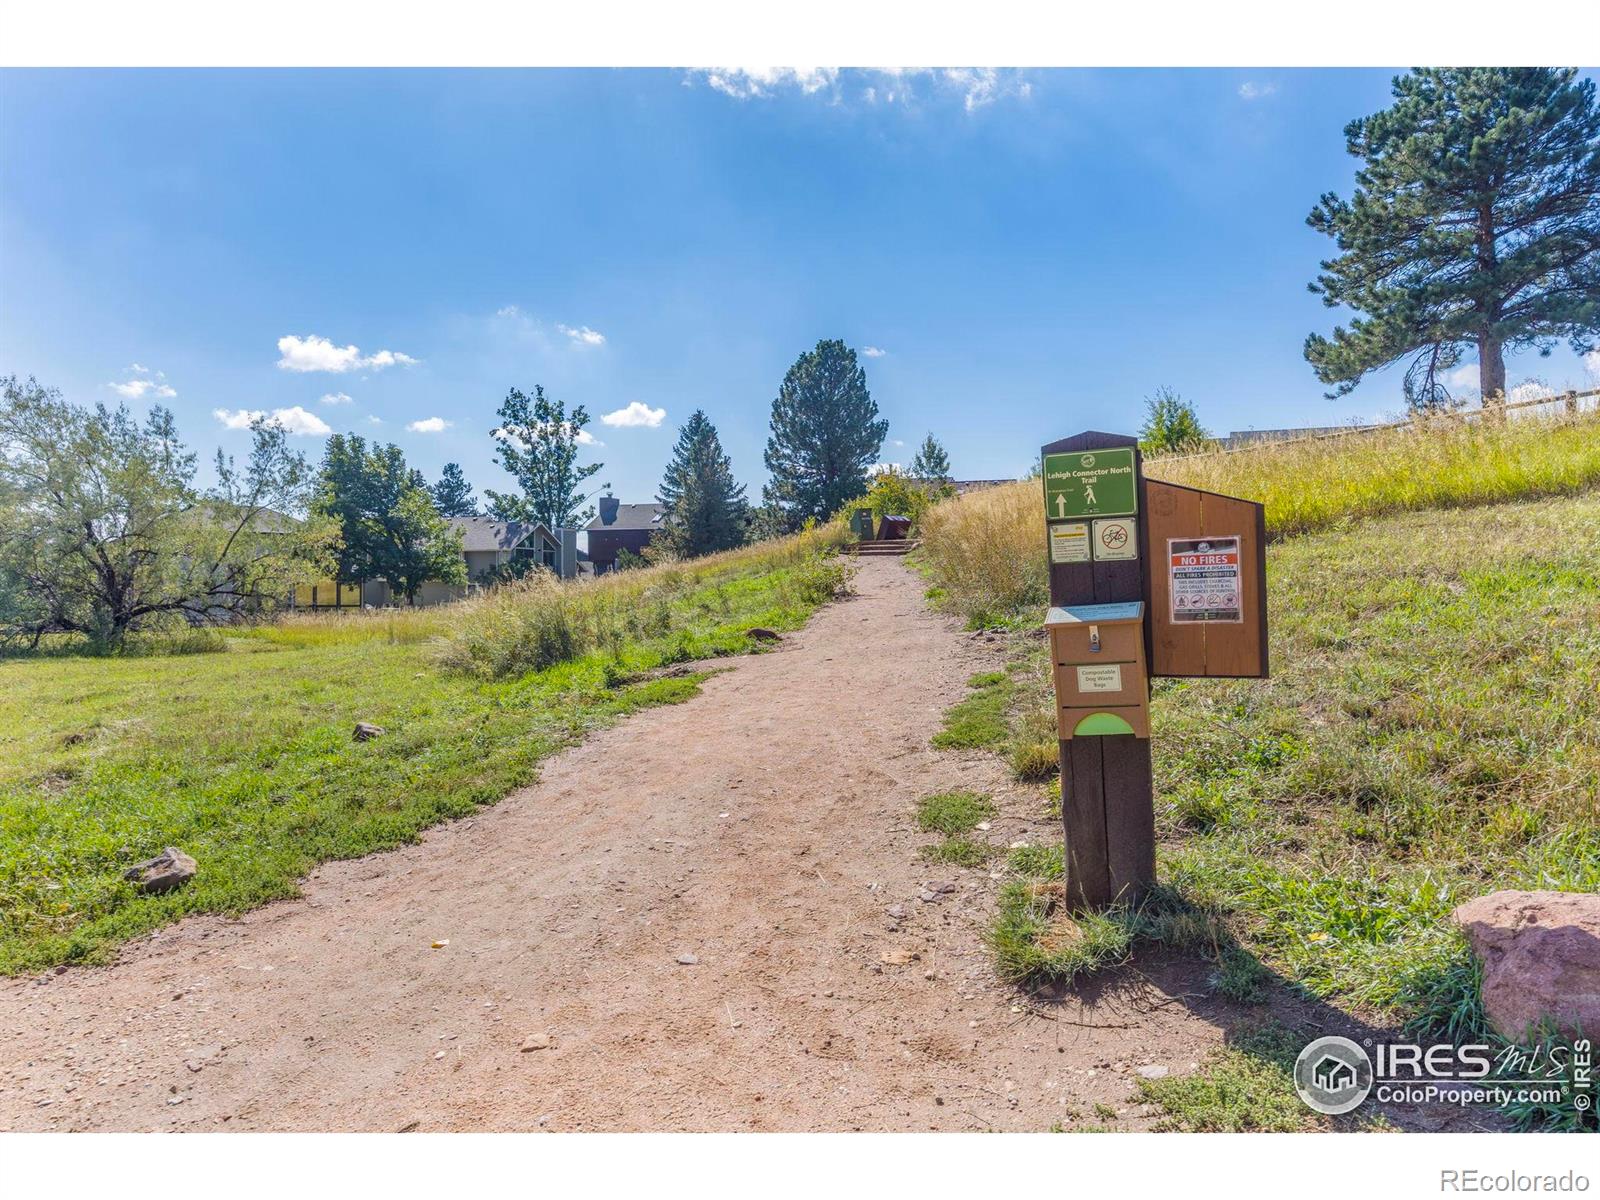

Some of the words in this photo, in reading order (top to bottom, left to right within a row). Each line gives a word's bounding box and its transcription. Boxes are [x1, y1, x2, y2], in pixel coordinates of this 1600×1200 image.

[1047, 471, 1071, 480] Lehigh
[1072, 469, 1109, 477] Connector
[1110, 466, 1131, 474] North
[1081, 476, 1097, 484] Trail
[1181, 556, 1197, 565] NO
[1200, 555, 1228, 565] FIRES
